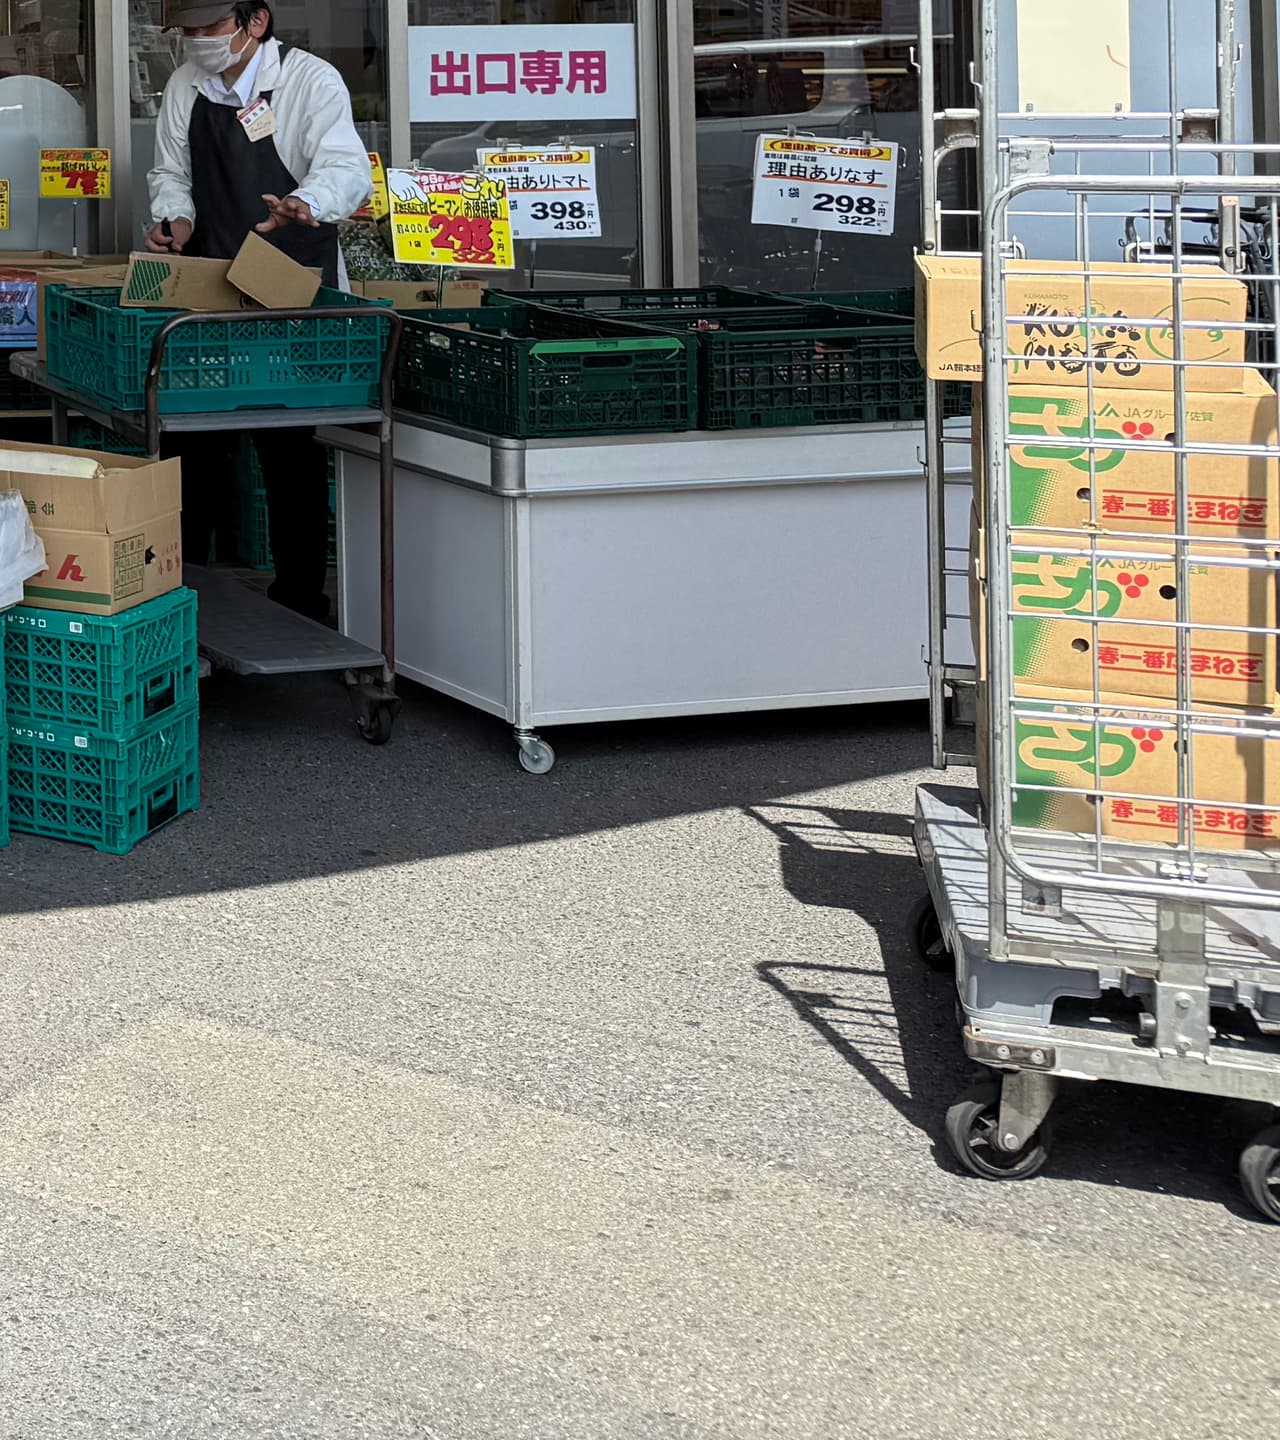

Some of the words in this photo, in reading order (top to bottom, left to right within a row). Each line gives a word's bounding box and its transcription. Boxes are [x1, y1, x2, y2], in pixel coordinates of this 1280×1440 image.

[430, 50, 607, 96] 出口専用
[507, 173, 589, 190] 由ありトマト
[767, 161, 883, 185] 理由ありなす
[530, 200, 587, 221] 398
[778, 186, 800, 199] 1袋
[812, 193, 877, 216] 298
[553, 220, 588, 231] 430
[838, 215, 877, 228] 322
[429, 215, 493, 251] 298
[1118, 558, 1209, 577] JAグルー賀
